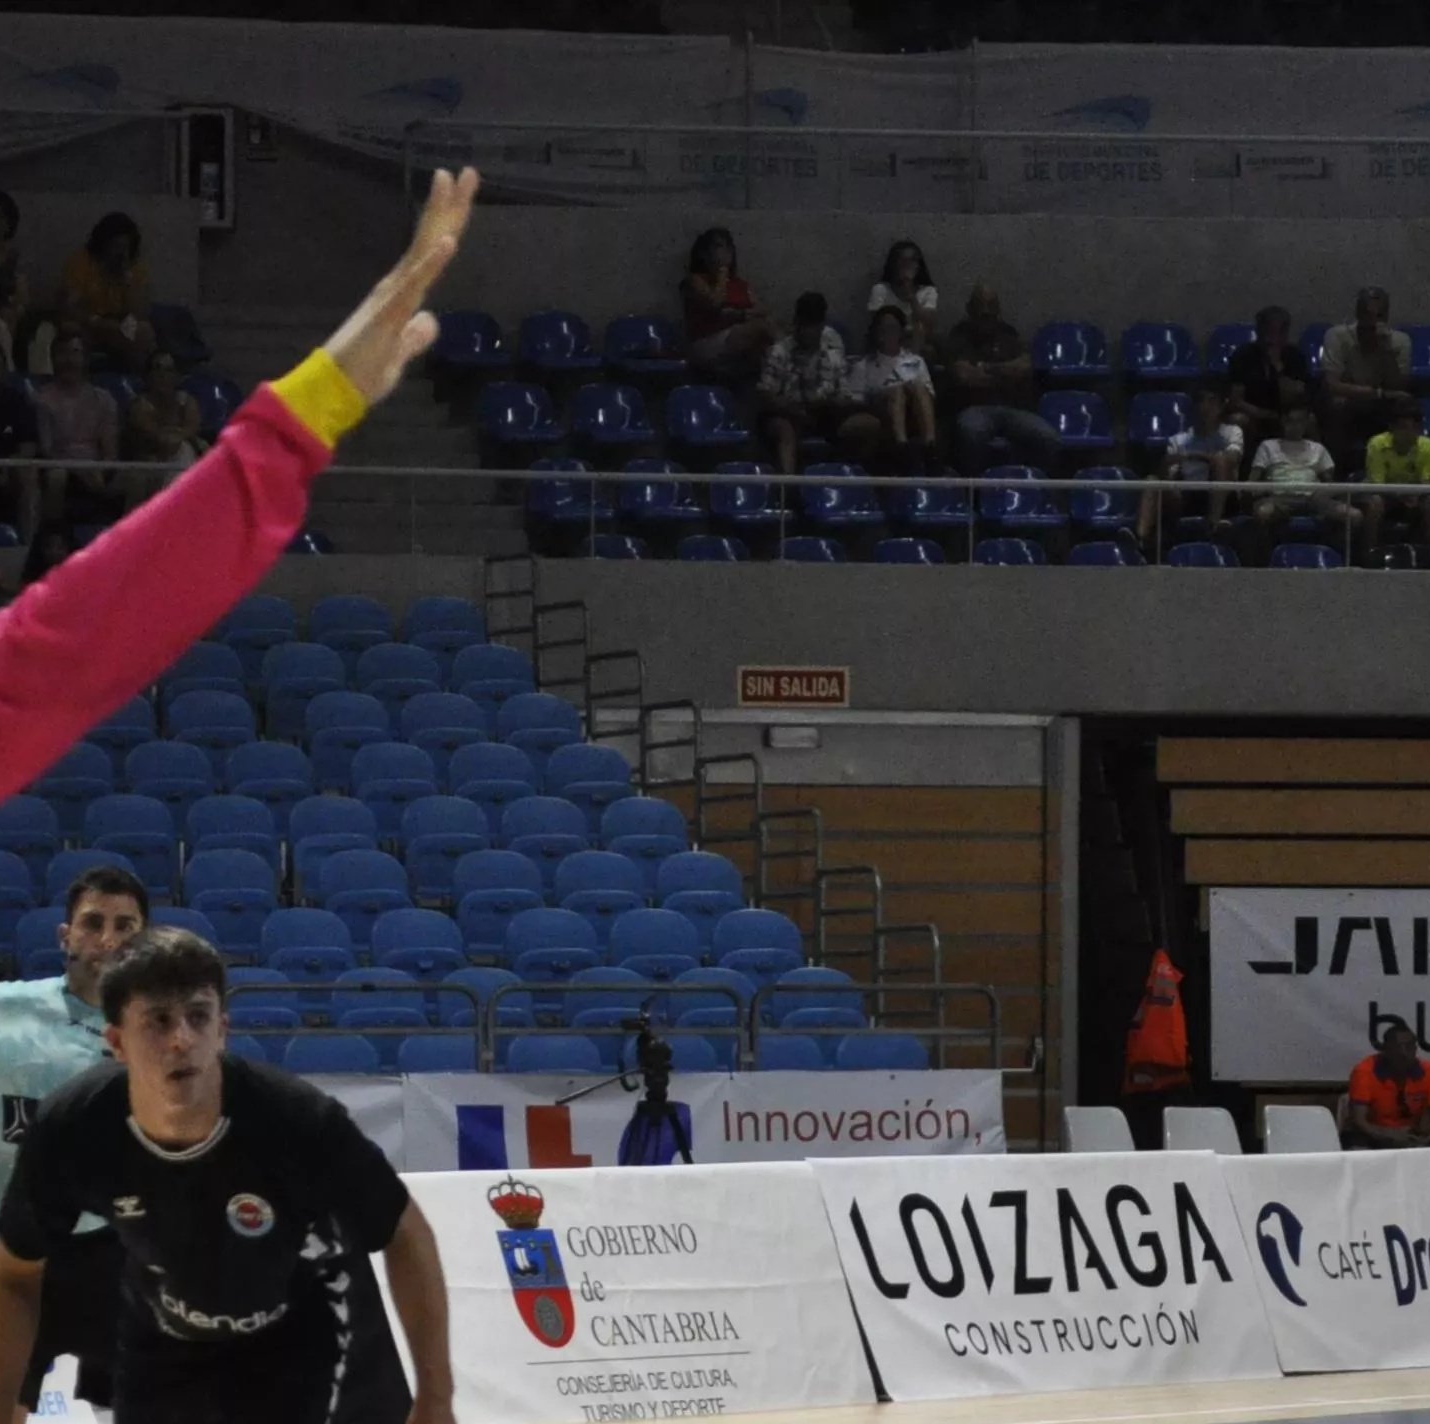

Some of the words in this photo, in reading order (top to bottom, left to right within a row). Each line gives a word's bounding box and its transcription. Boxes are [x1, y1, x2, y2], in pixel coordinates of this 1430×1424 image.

[745, 676, 774, 696] SIN
[780, 676, 840, 697] SALIDA
[722, 1099, 983, 1147] Innovación,
[567, 1221, 698, 1259] GOBIERNO
[849, 1181, 1233, 1300] LOIZAGA
[1317, 1228, 1379, 1282] CAFÉ
[580, 1272, 606, 1302] de
[590, 1310, 743, 1348] CANTABRIA
[944, 1302, 1202, 1359] CONSTRUCCIÓN
[556, 1370, 647, 1396] CONSEJERÍA
[647, 1372, 669, 1391] DE
[671, 1368, 738, 1390] CULTURA,
[580, 1401, 647, 1424] TURISMO
[647, 1400, 659, 1420] Y
